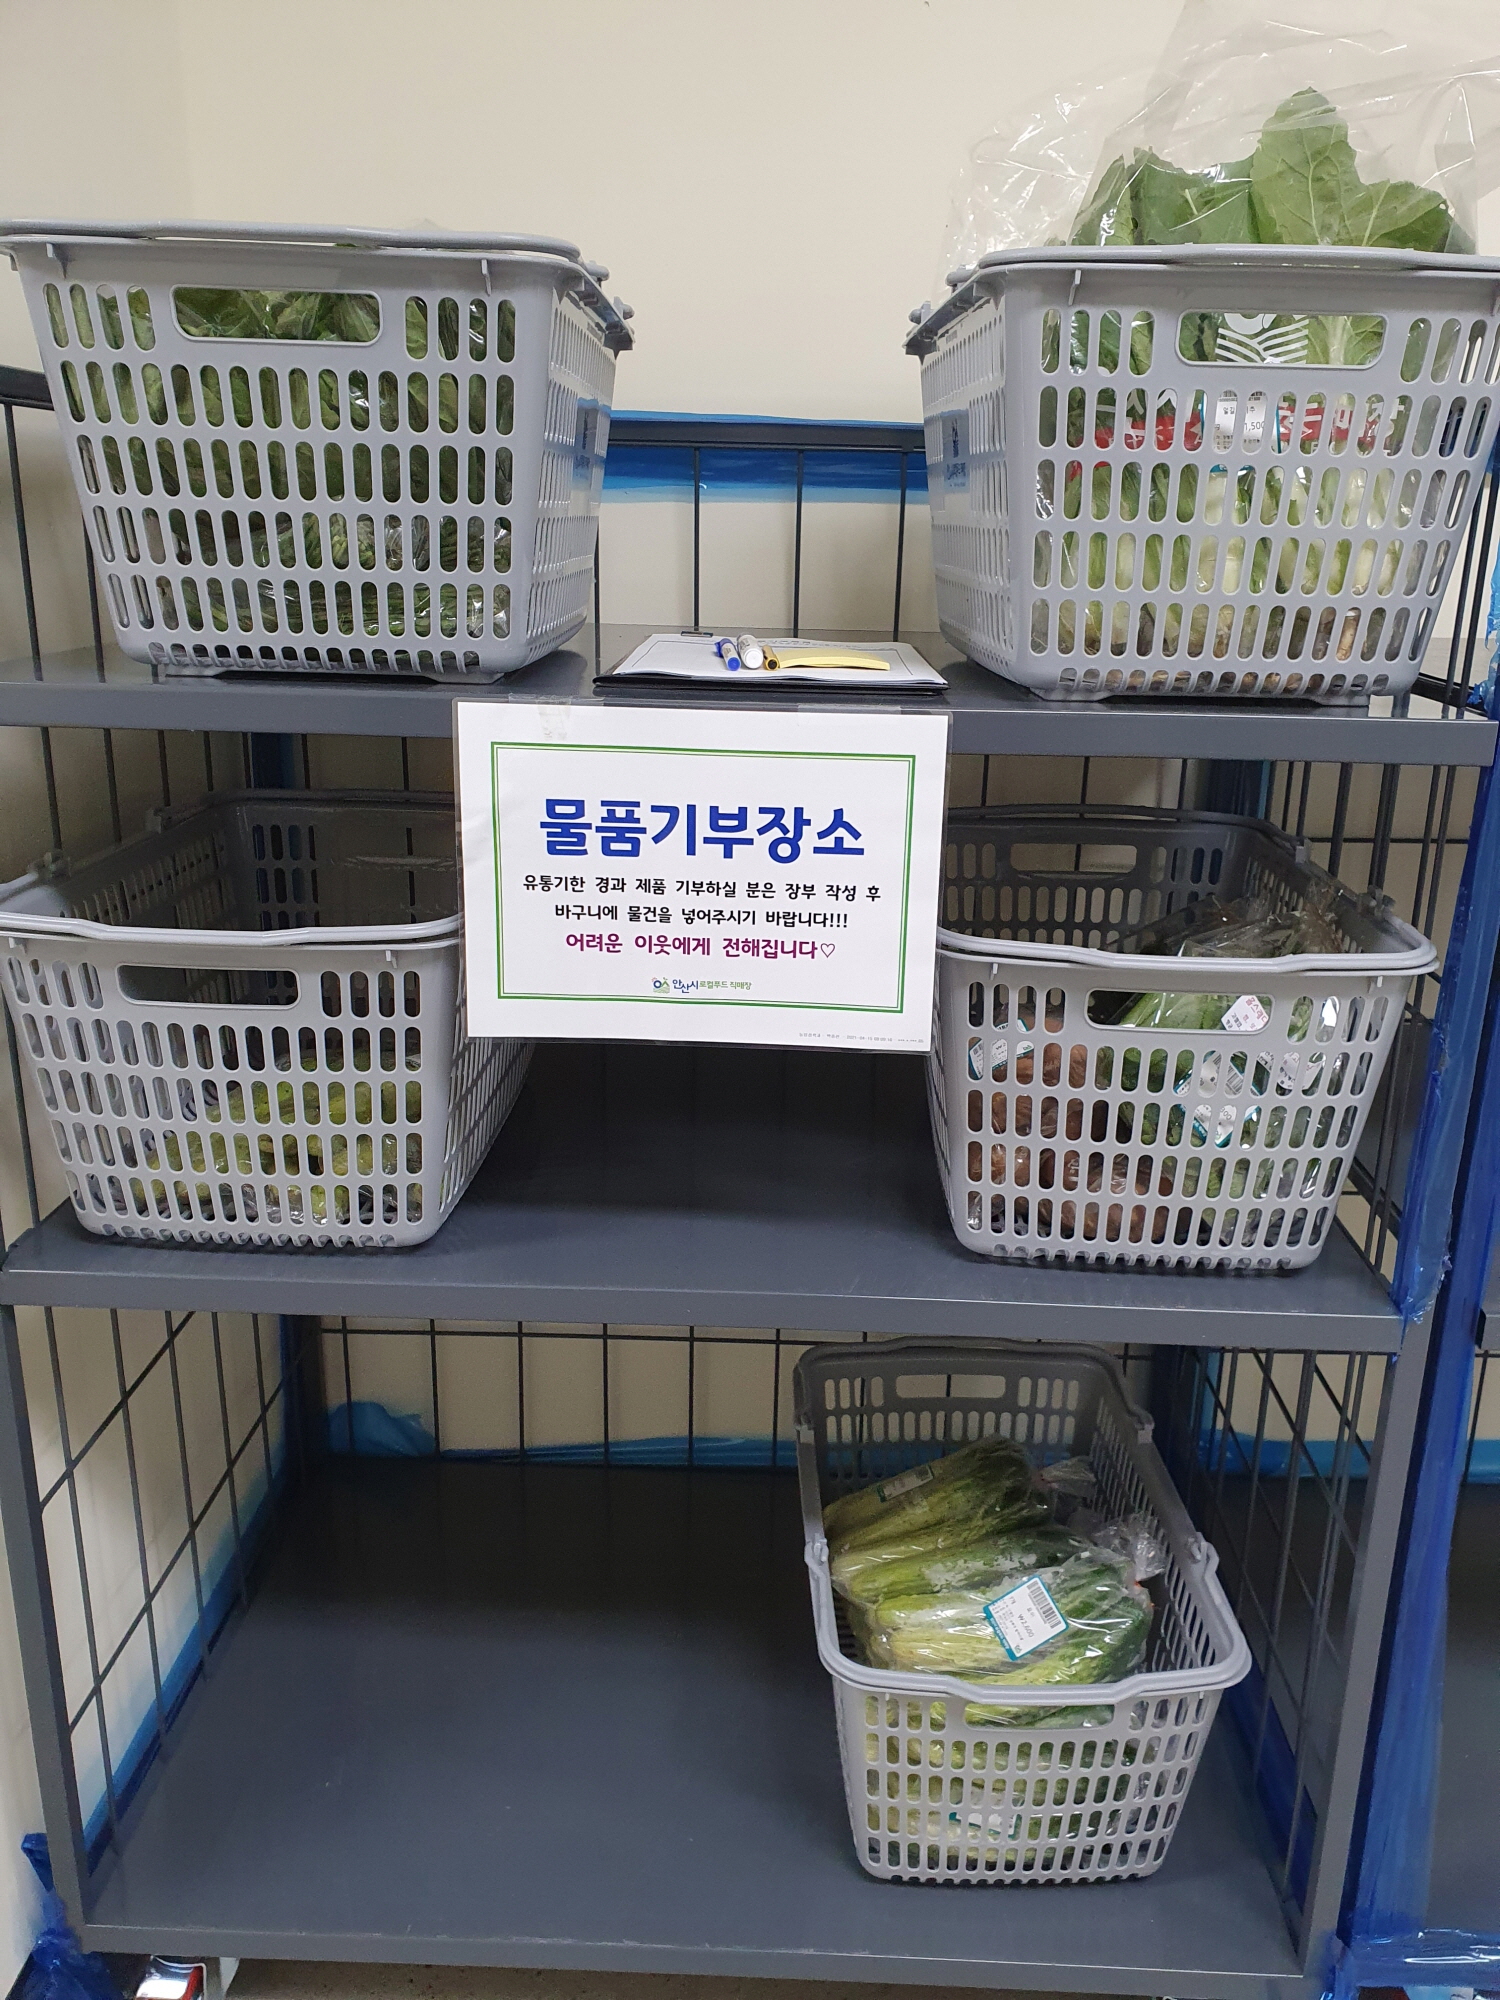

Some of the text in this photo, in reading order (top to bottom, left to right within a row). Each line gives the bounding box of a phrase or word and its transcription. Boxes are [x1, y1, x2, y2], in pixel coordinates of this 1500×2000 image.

[539, 798, 865, 864] 물품기부장소
[522, 874, 881, 902] 유통기한 경과 제품 기부하실 분은 장부 작성 후
[555, 904, 848, 928] 바구니에 물건을 넣어주시기 바랍니다!!!
[565, 933, 624, 954] 어려운
[634, 934, 711, 956] 이웃에게
[729, 981, 752, 991] 직매장
